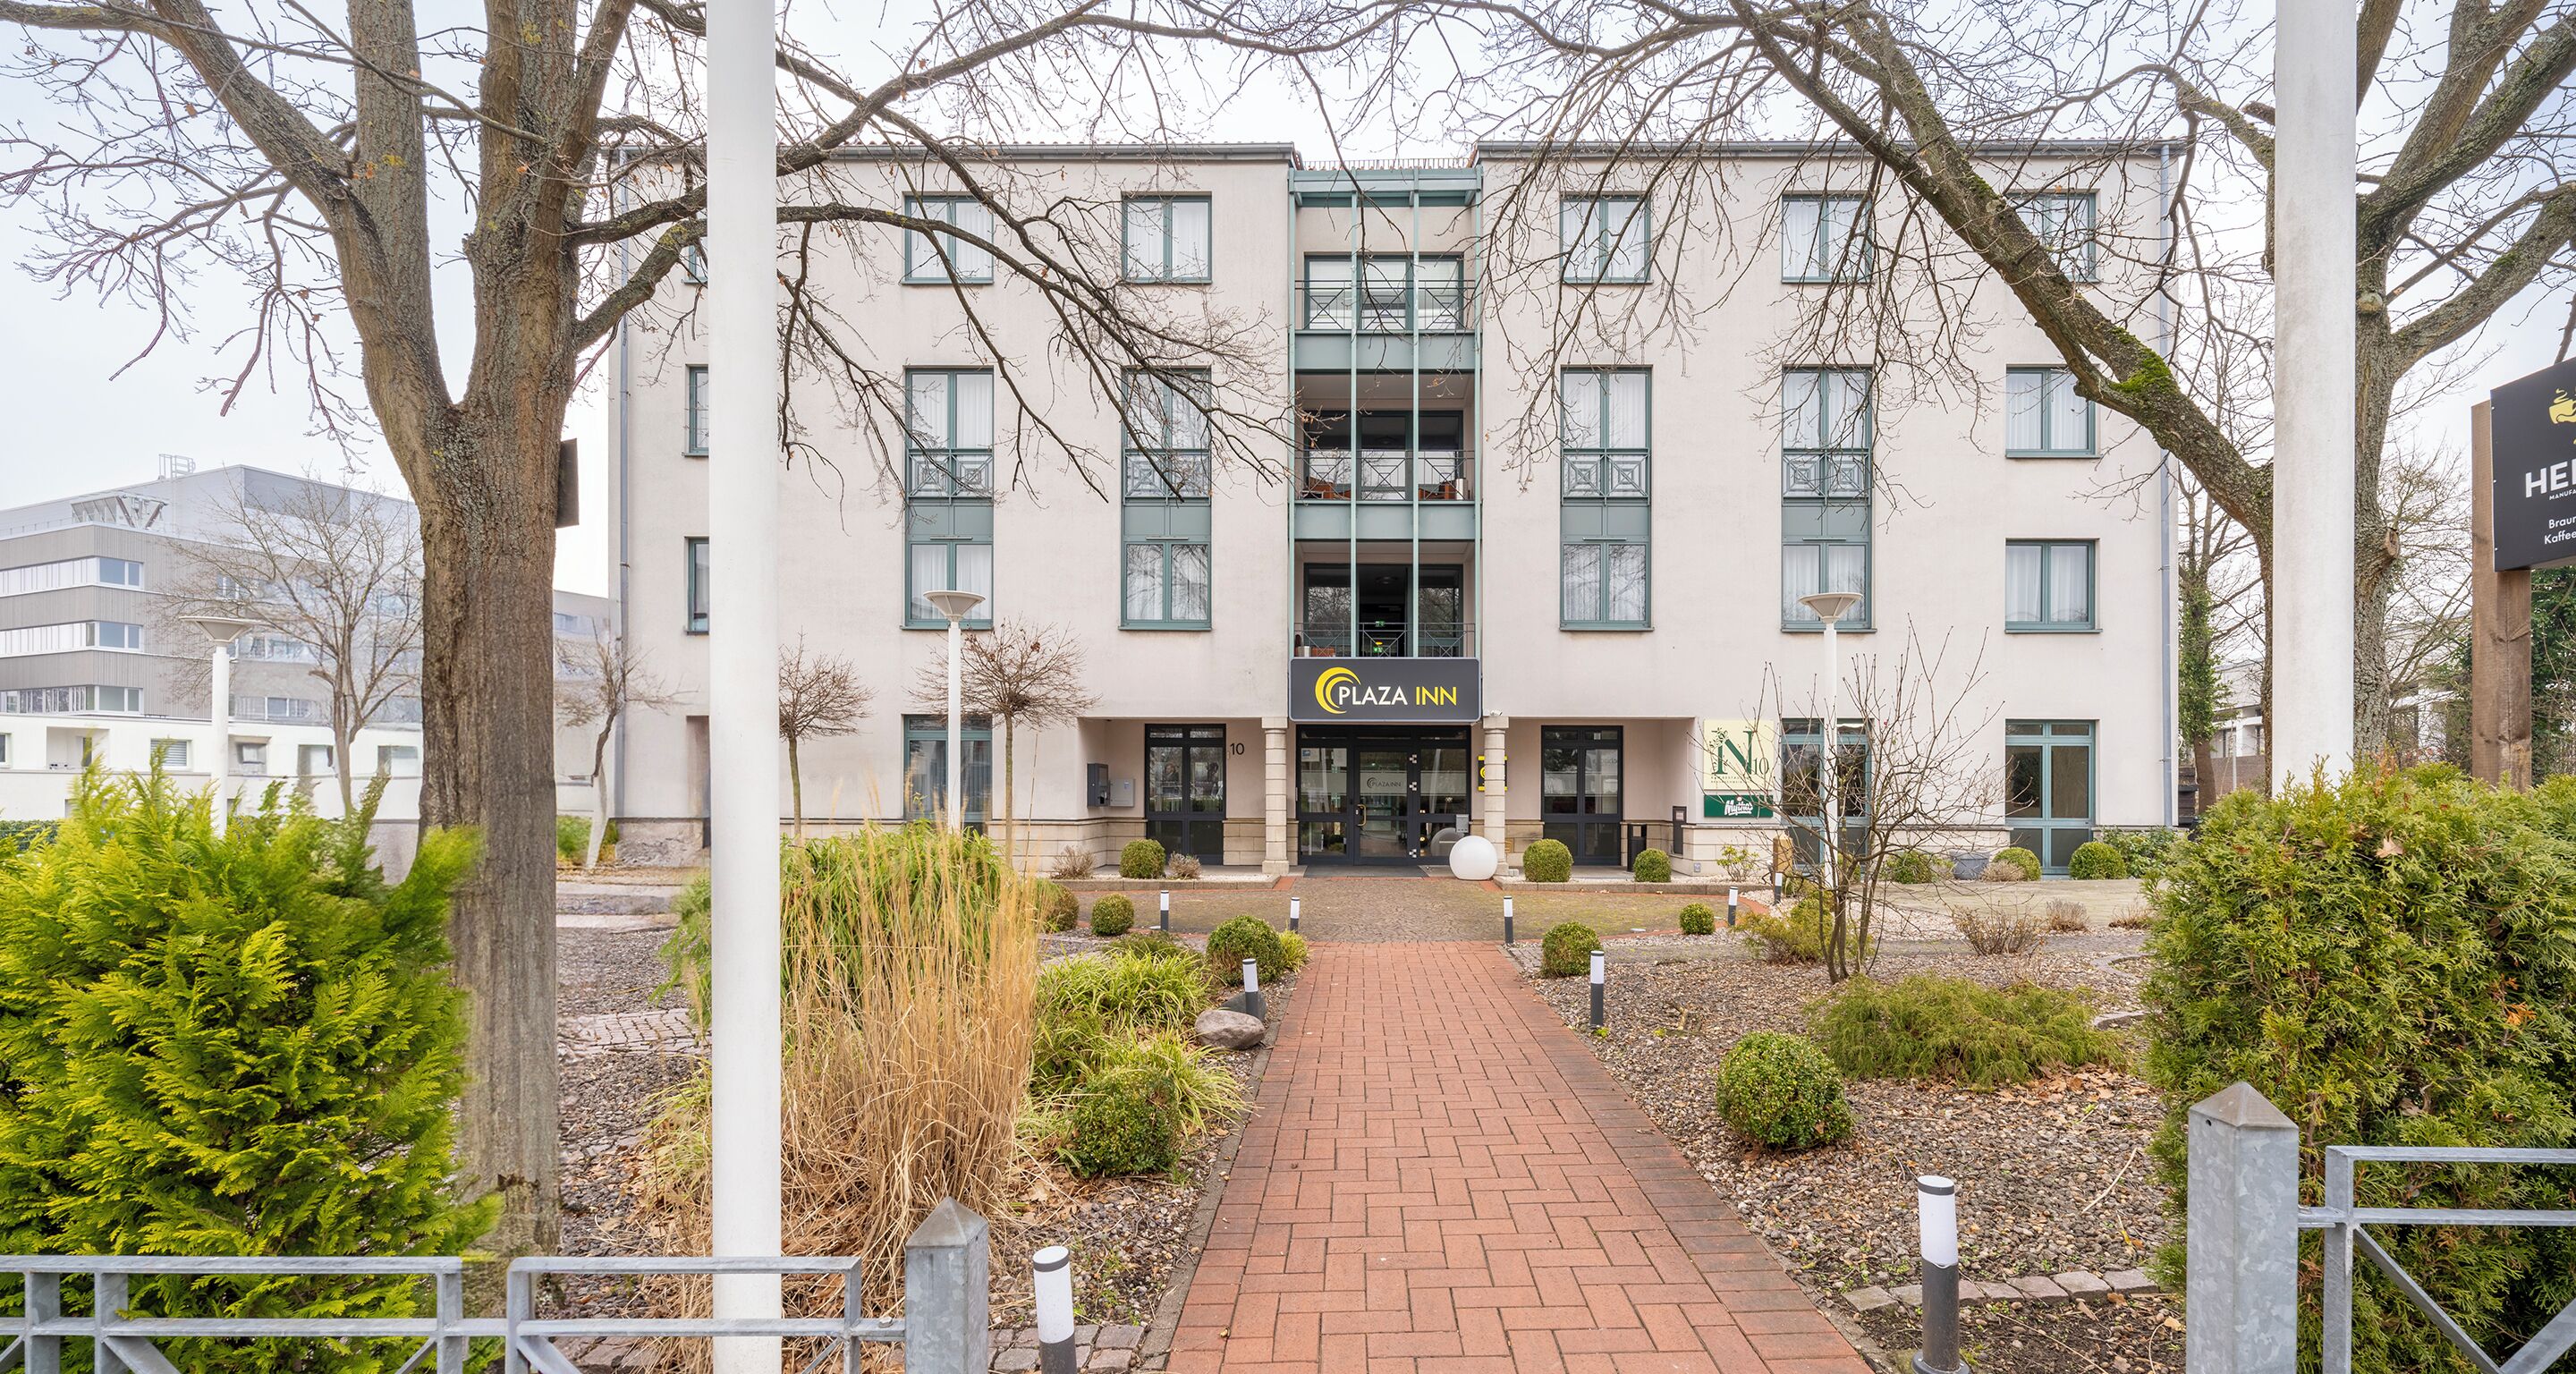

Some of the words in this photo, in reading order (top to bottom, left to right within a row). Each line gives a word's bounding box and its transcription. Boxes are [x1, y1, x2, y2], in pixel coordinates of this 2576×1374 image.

[2544, 530, 2576, 545] Kaffee
[1338, 686, 1408, 706] PLAZA
[1416, 686, 1457, 706] INN
[1230, 742, 1245, 756] 10
